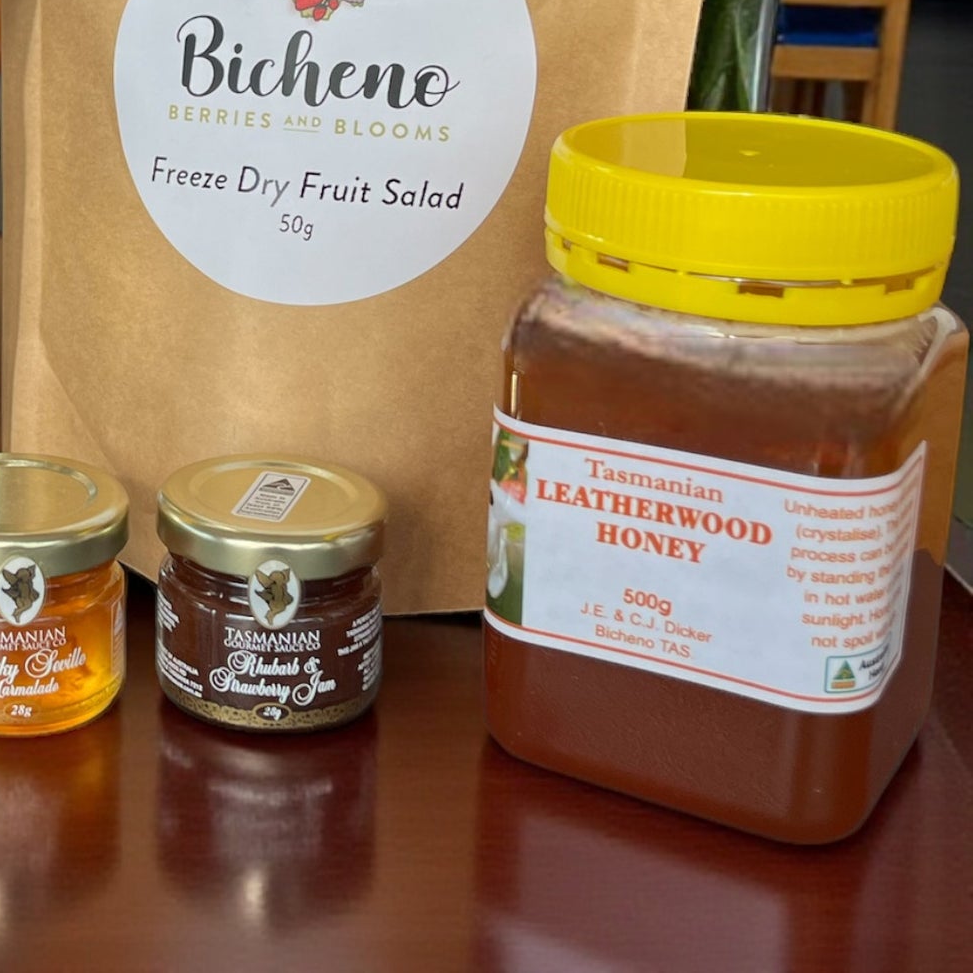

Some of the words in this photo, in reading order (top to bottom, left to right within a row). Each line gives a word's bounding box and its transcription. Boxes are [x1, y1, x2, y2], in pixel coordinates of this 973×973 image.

[177, 15, 461, 109] Bicheno
[168, 104, 272, 129] BERRIES
[284, 115, 322, 129] AND
[334, 118, 451, 143] BLOOMS
[151, 156, 228, 190] Freeze
[238, 165, 290, 207] Dry
[300, 172, 371, 204] Fruit
[382, 178, 464, 210] Salad
[279, 213, 314, 241] 50g
[585, 457, 724, 503] Tasmanian
[536, 478, 773, 546] LEATHERWOOD
[784, 498, 865, 520] Unheated
[596, 521, 707, 564] HONEY
[791, 546, 856, 563] process
[786, 565, 806, 582] by
[811, 566, 876, 584] standing
[623, 588, 672, 616] 500g
[804, 589, 819, 604] in
[825, 590, 851, 606] hot
[224, 627, 320, 644] TASMANIAN
[580, 601, 608, 619] J.E.
[614, 610, 625, 623] &
[630, 612, 659, 630] C.J.
[664, 615, 713, 644] Dicker
[22, 640, 51, 651] SAUCE
[53, 638, 66, 647] CO
[224, 640, 273, 653] GOURMET
[275, 642, 304, 653] SAUCE
[306, 641, 321, 651] CO
[595, 624, 656, 651] Bicheno
[811, 634, 837, 649] not
[844, 632, 874, 650] spoil
[25, 646, 87, 678] Seville
[227, 649, 299, 677] Rhubarb
[303, 656, 321, 673] &
[209, 666, 291, 704] Strawberry
[292, 670, 336, 706] Jam
[10, 704, 33, 717] 28g
[262, 705, 282, 721] 28g
